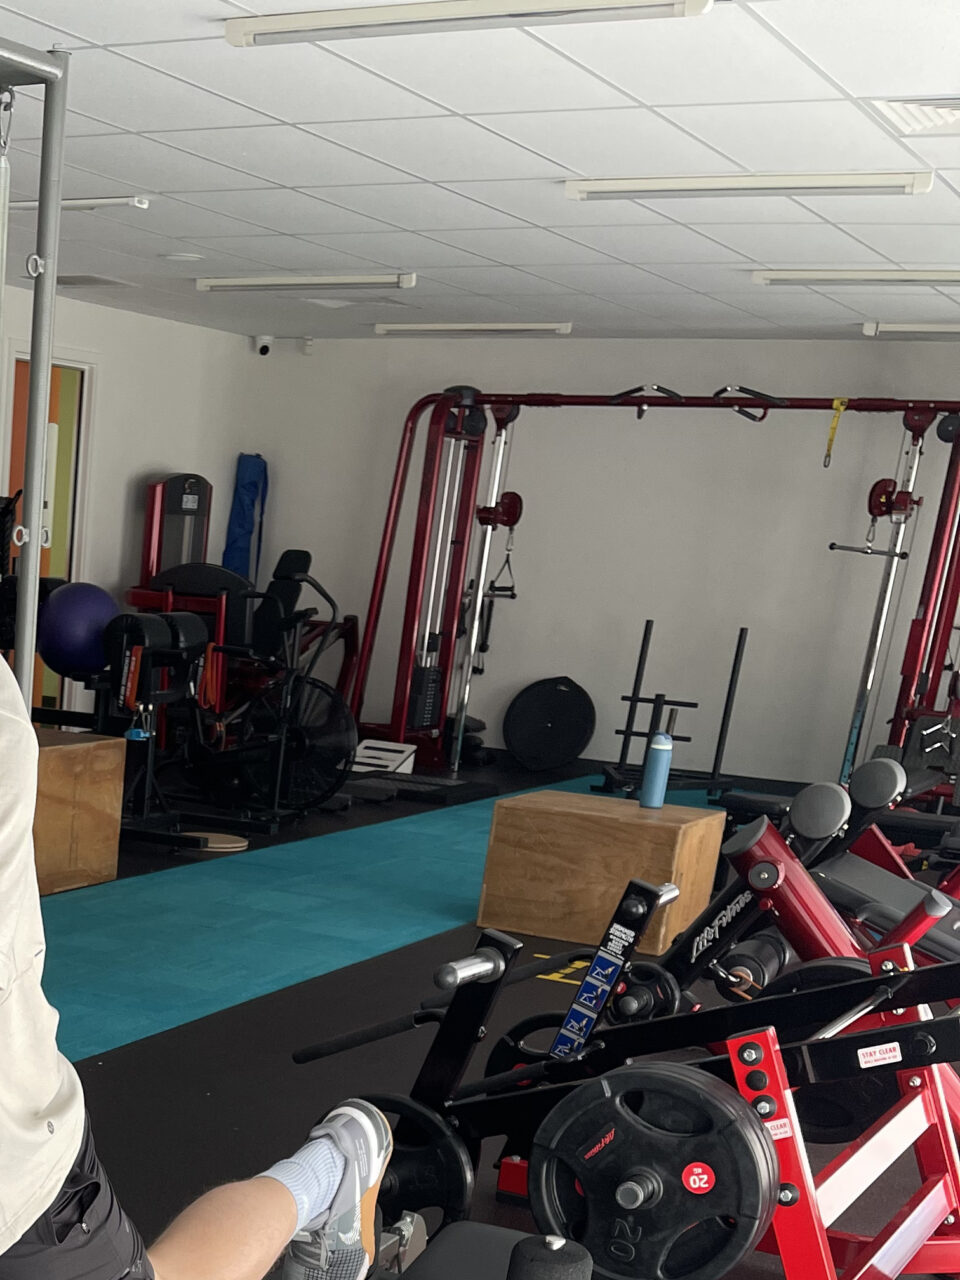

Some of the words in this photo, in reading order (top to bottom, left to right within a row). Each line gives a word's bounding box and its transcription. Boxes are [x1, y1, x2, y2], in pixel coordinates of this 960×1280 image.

[861, 1050, 877, 1059] STAY
[878, 1046, 897, 1056] CLEAR
[689, 1175, 709, 1188] 20
[610, 1218, 642, 1263] 20
